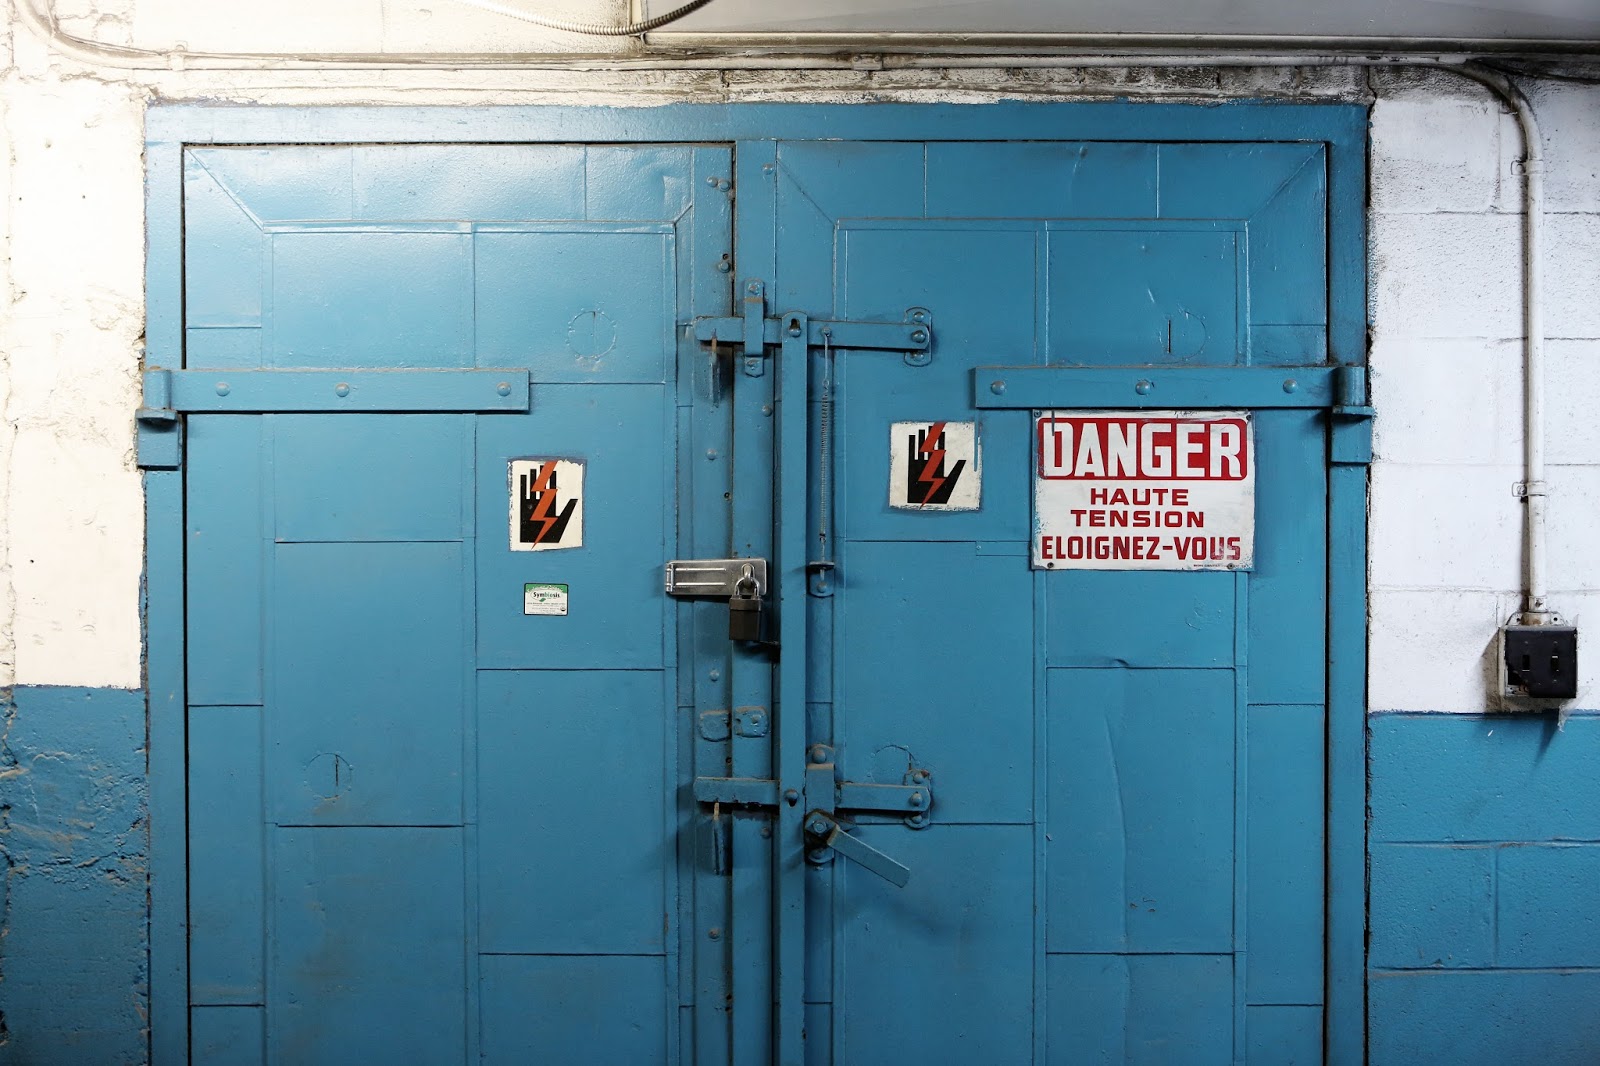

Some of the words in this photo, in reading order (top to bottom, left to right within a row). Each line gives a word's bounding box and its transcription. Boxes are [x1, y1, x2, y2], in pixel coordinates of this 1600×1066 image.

[1043, 422, 1242, 478] DANGER
[1090, 488, 1189, 506] HAUTE
[1070, 510, 1204, 528] TENSION
[1041, 536, 1241, 561] ELOIGNEZ-VOUS
